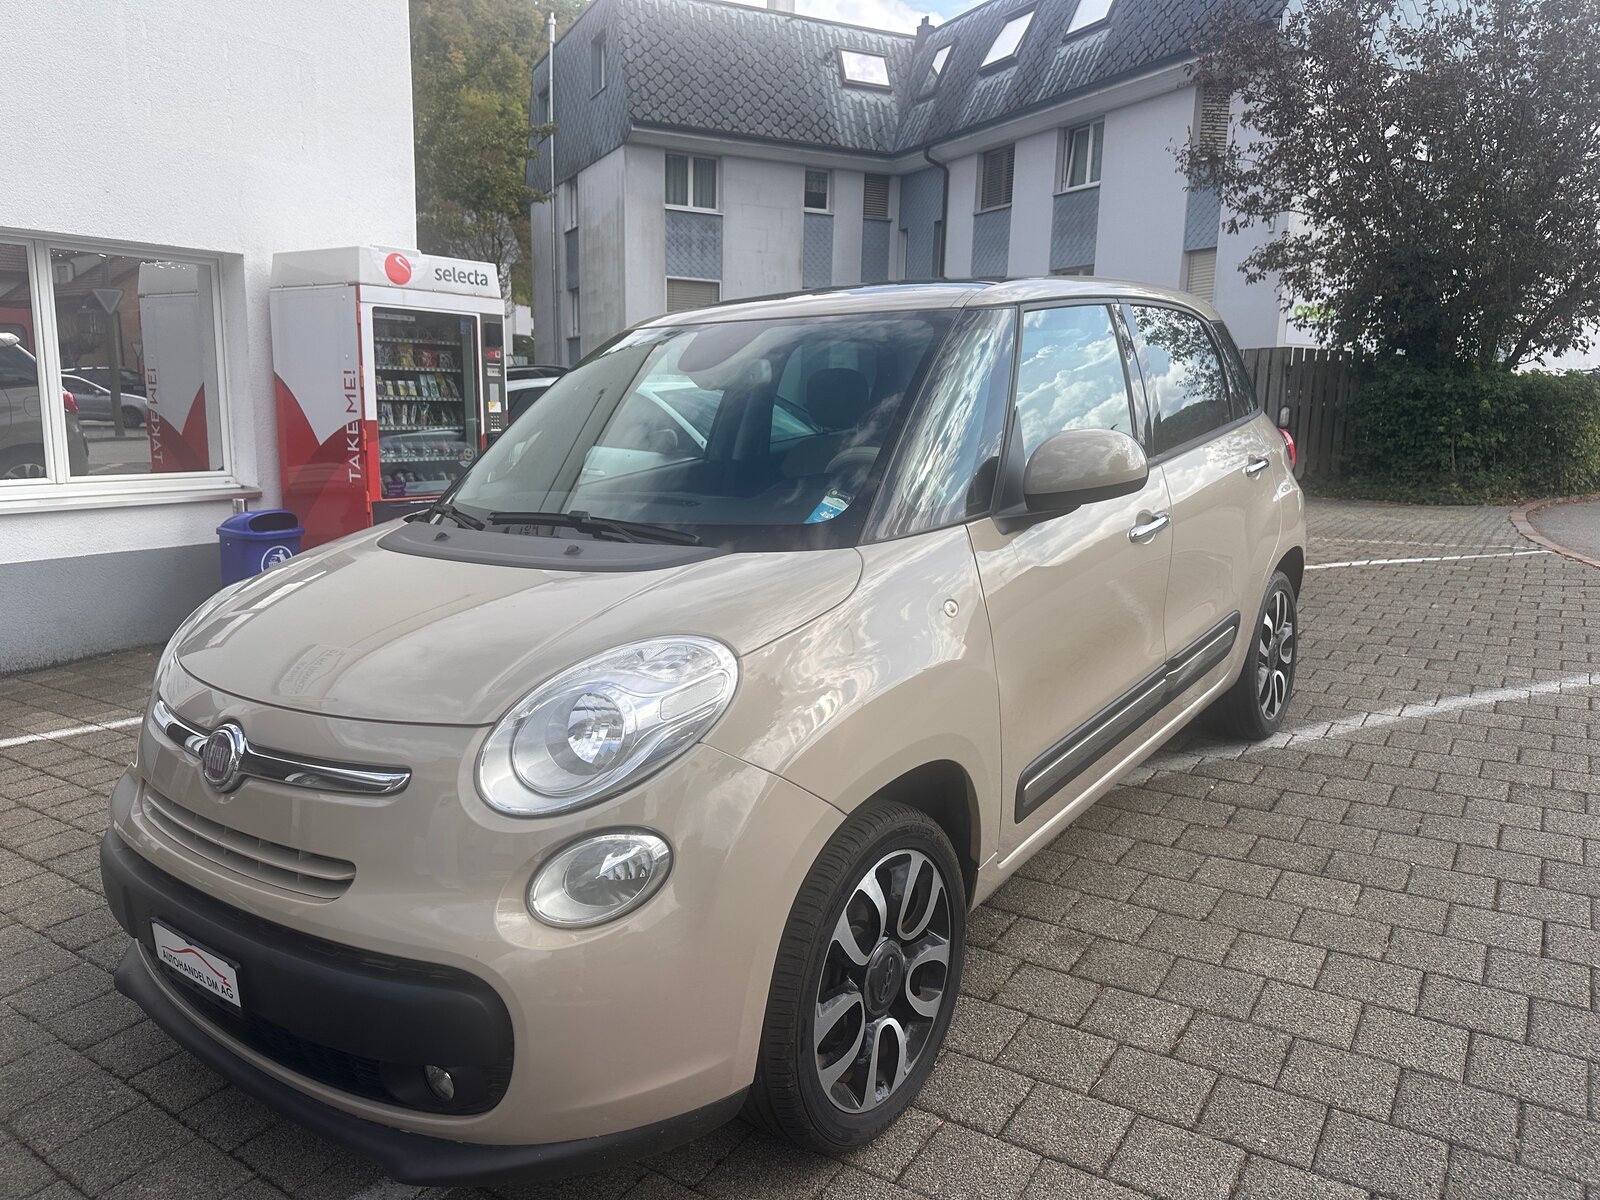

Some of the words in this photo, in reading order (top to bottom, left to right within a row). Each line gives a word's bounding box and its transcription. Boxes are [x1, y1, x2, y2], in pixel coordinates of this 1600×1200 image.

[434, 266, 489, 287] selecta
[343, 370, 358, 413] ME!
[345, 421, 361, 483] TAKE
[162, 949, 207, 984] AUTOHANDEL
[206, 976, 220, 992] DM
[220, 984, 234, 999] AG
